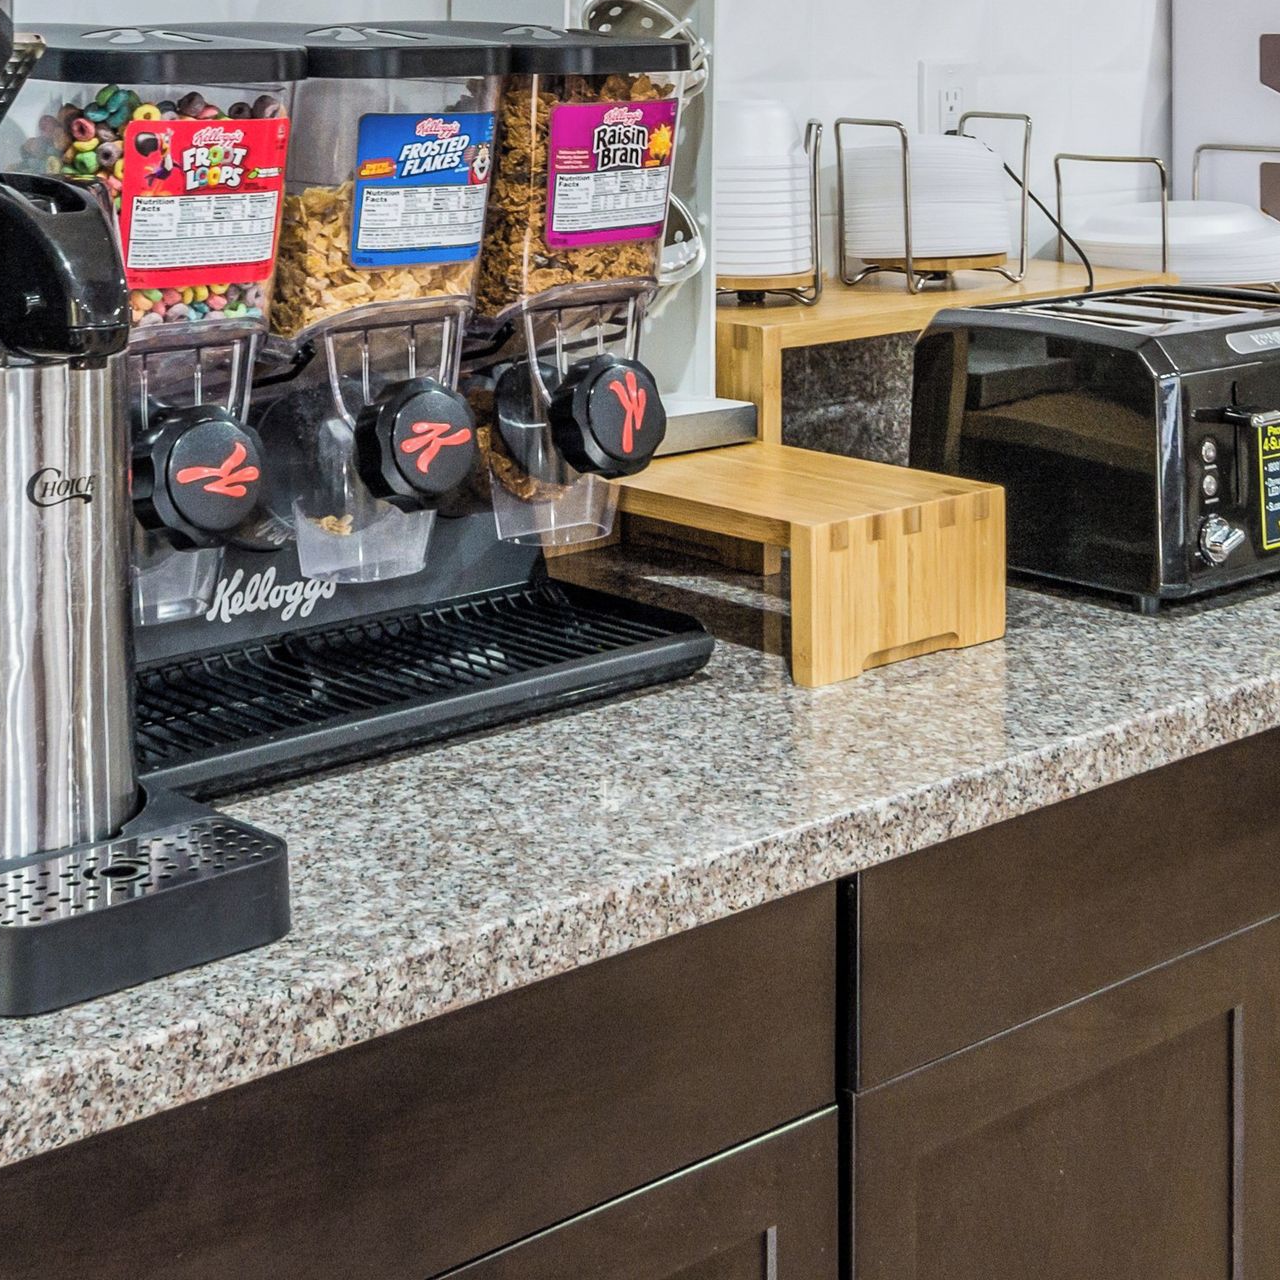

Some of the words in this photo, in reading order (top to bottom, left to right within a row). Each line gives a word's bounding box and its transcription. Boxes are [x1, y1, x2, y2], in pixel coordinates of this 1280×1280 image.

[399, 135, 470, 162] FROSTED
[595, 126, 647, 151] Raisin
[182, 145, 248, 171] FROOT
[401, 151, 463, 178] FLAKES
[600, 147, 640, 168] Bran
[185, 164, 244, 191] LOOPS
[135, 197, 176, 205] Nutrition
[135, 204, 161, 212] Facts
[26, 467, 96, 507] CHOICE
